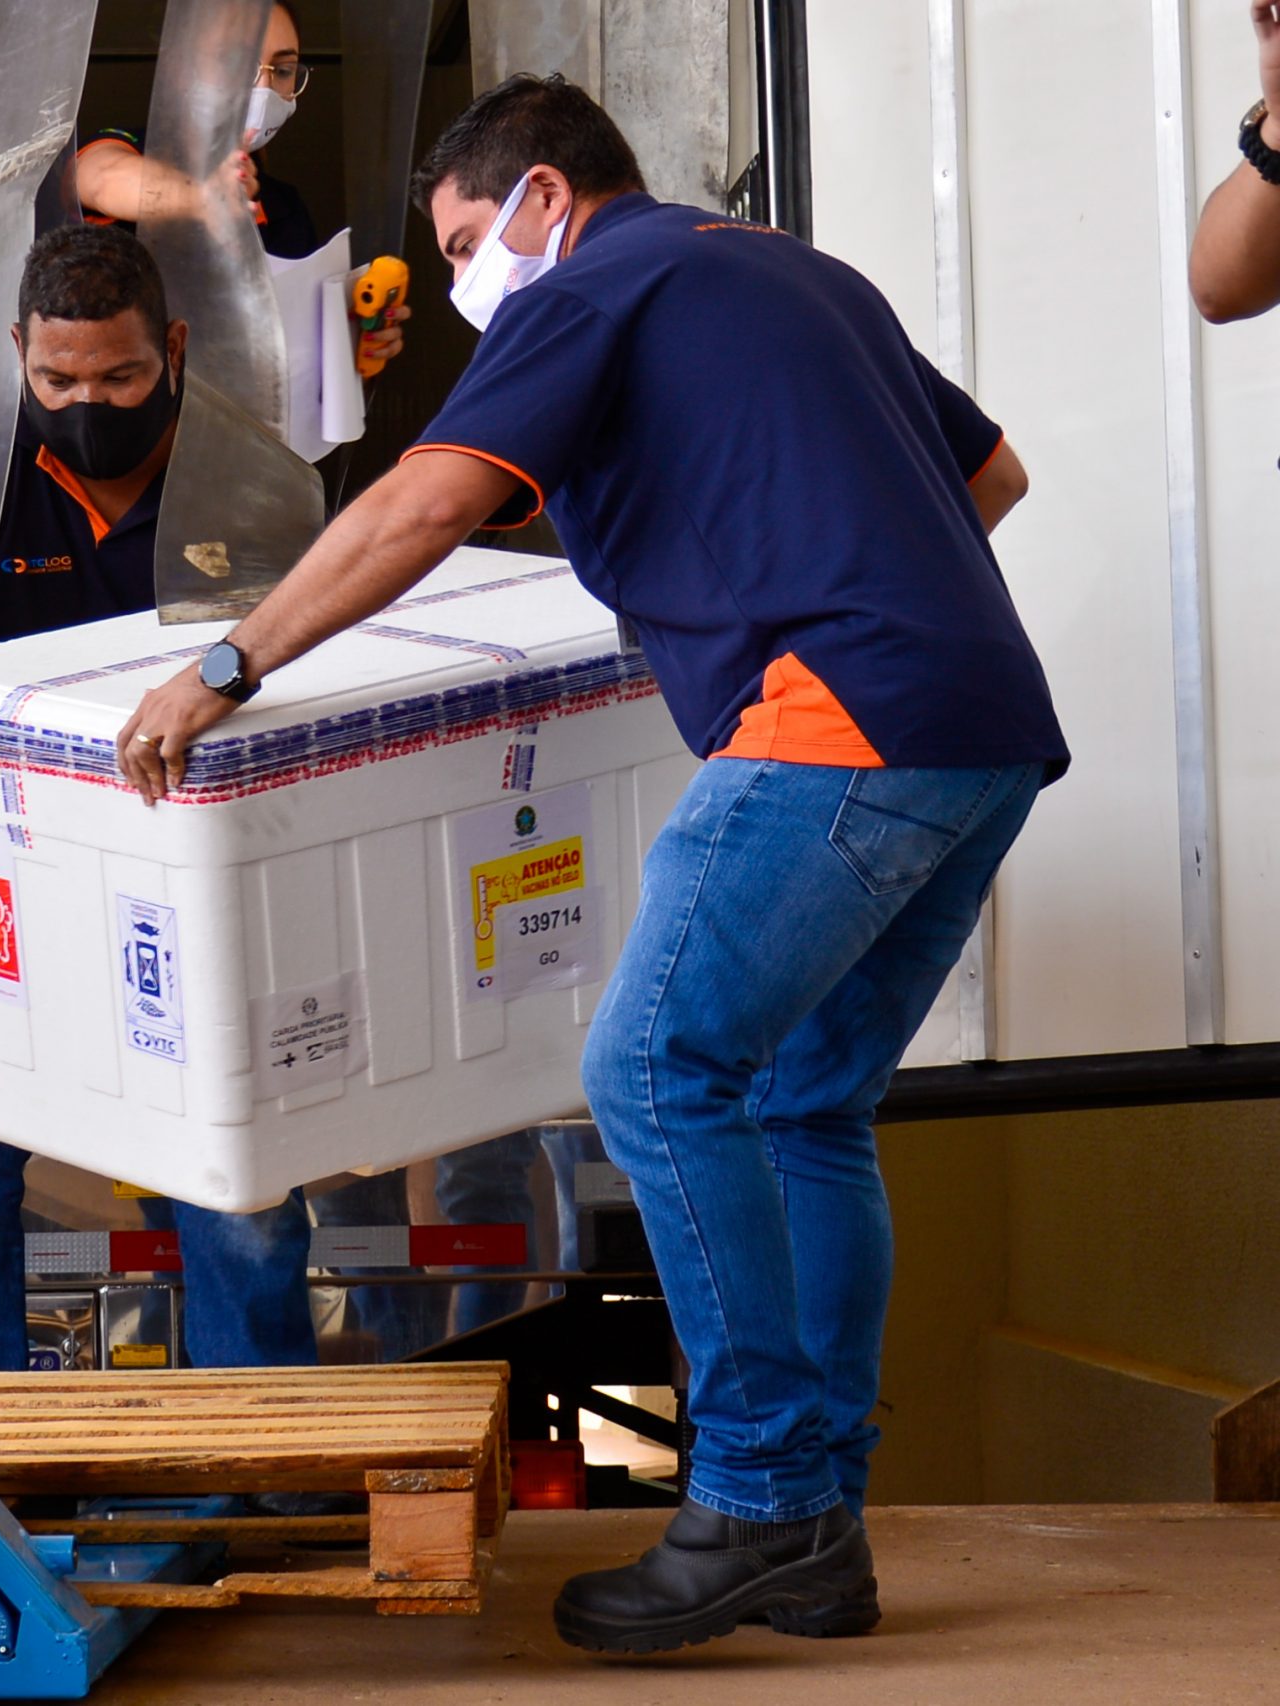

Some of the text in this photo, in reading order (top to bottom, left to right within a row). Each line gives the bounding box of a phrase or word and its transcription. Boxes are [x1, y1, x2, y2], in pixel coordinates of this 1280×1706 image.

[522, 848, 580, 881] ATENÇÃO
[519, 905, 582, 937] 339714
[539, 950, 560, 966] GO
[272, 1025, 298, 1038] CARGA
